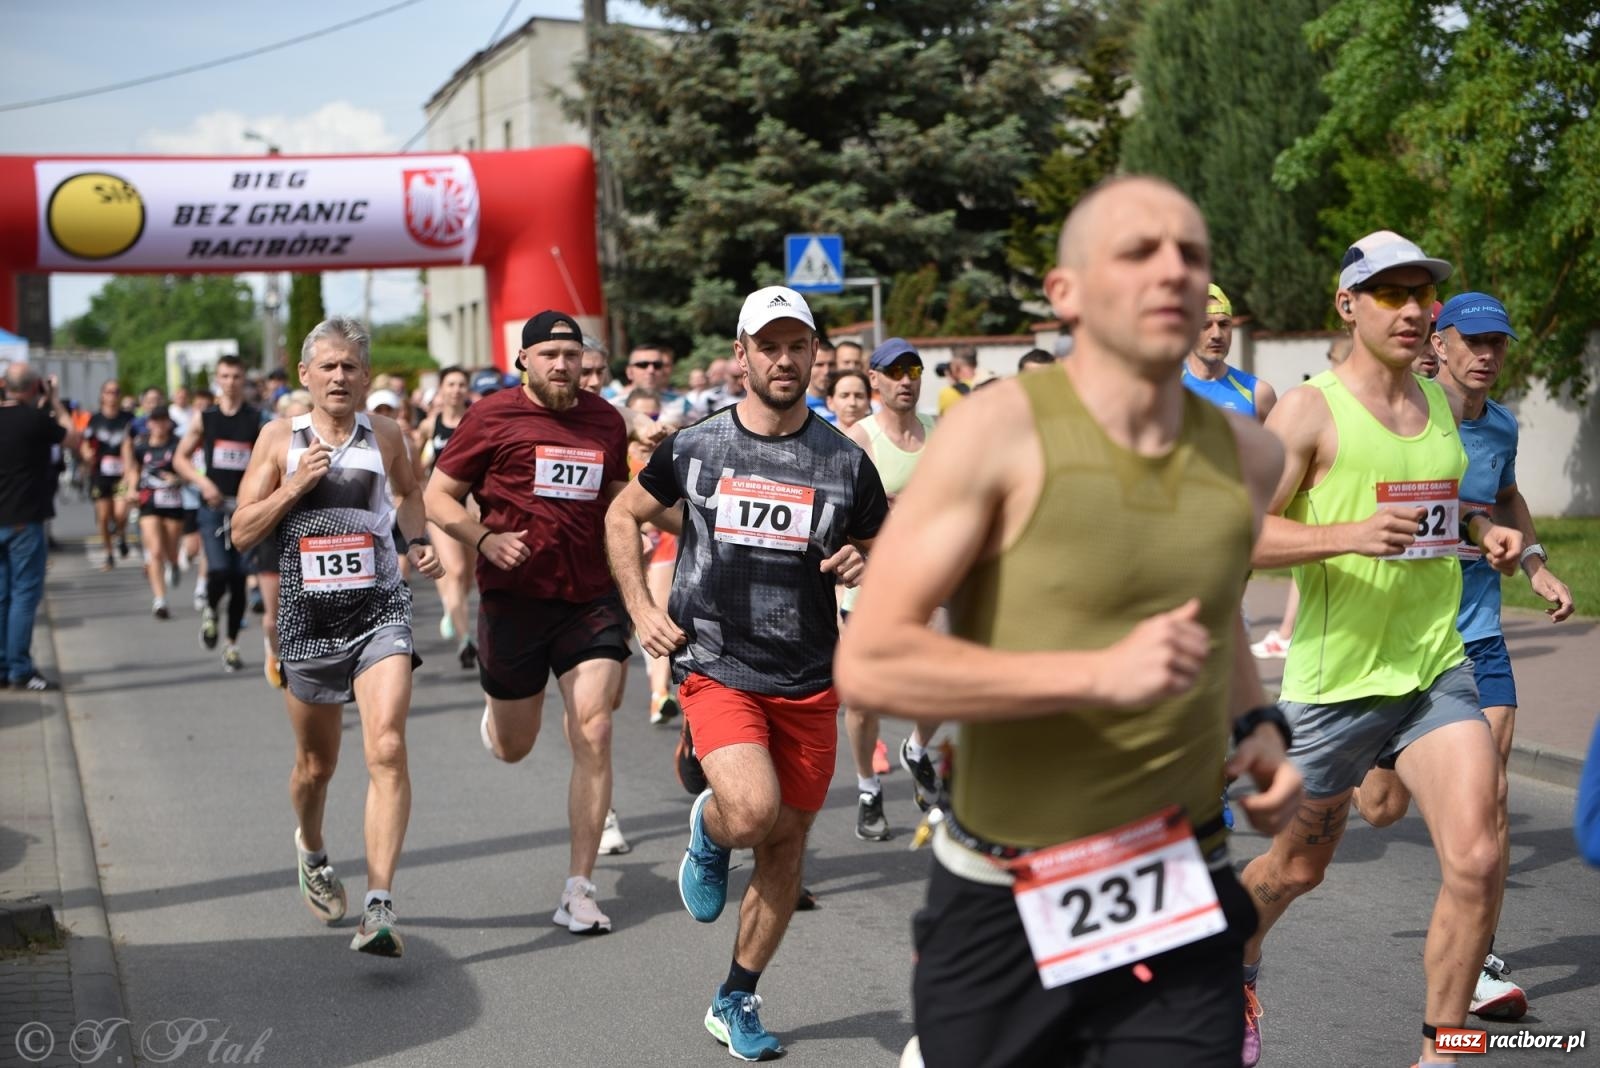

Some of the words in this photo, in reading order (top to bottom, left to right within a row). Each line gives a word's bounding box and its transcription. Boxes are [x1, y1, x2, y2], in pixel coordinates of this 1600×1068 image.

[231, 171, 307, 190] BIEG
[172, 204, 238, 227] BEZ
[247, 200, 370, 226] GRANIC
[187, 232, 353, 259] RACIBÓRZ
[1461, 306, 1480, 315] RUN
[552, 463, 589, 486] 217
[746, 482, 761, 490] BIEG
[776, 485, 803, 495] GRANIC
[1388, 484, 1401, 492] XVI
[1430, 482, 1452, 490] GRANIC
[739, 500, 792, 531] 170
[316, 552, 362, 576] 135
[1060, 861, 1165, 939] 237
